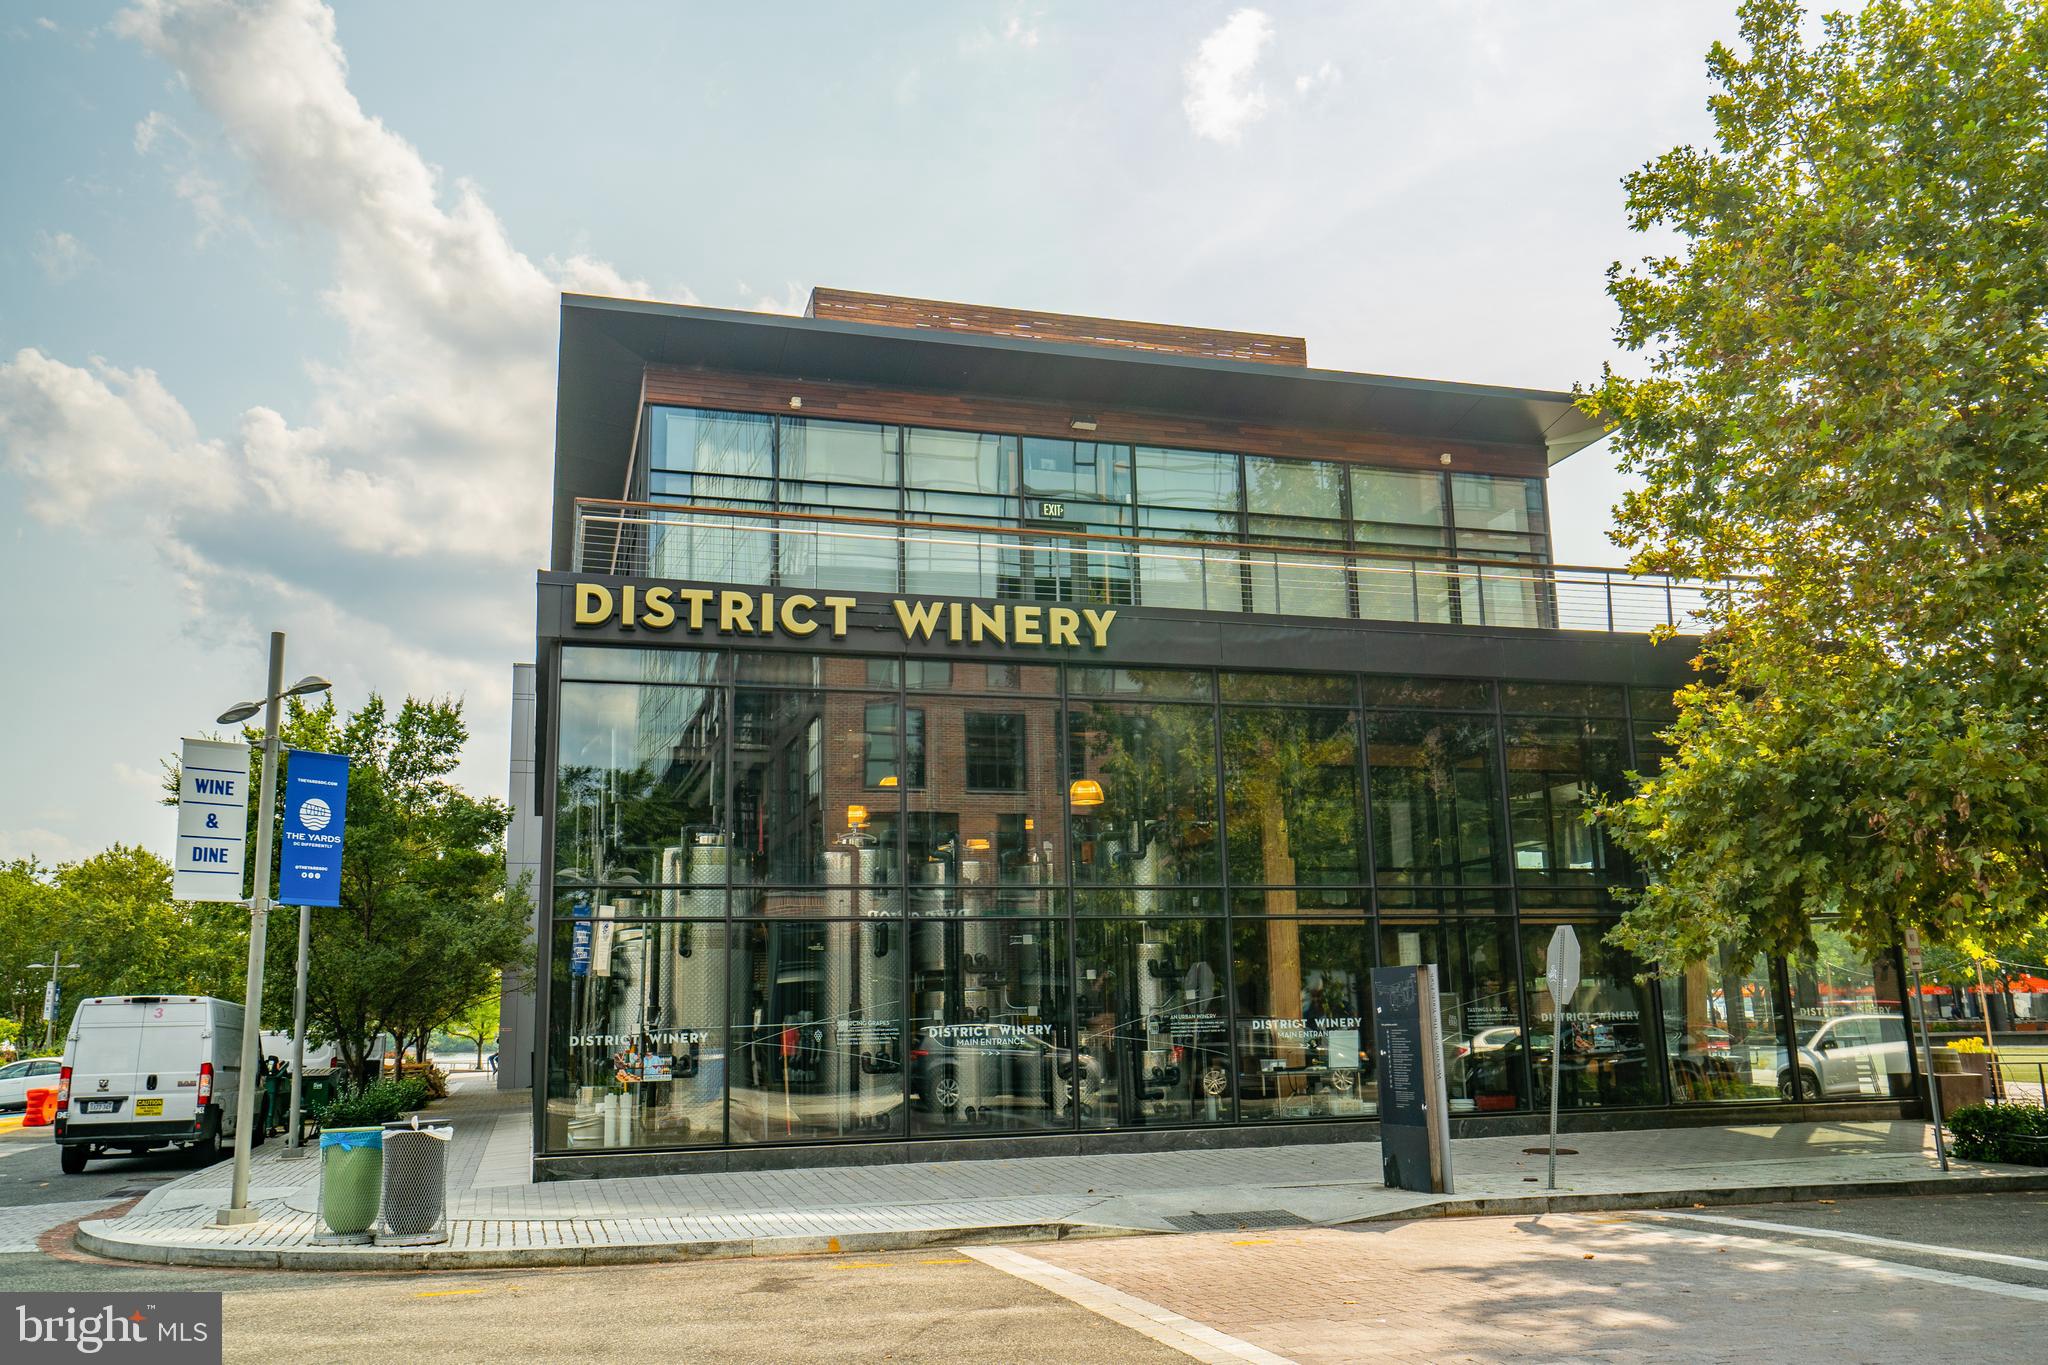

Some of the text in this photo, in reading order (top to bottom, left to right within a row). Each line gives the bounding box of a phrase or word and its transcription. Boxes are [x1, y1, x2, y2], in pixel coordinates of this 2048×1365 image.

[1043, 503, 1061, 516] EXIT
[574, 582, 1118, 648] DISTRICT WINERY
[195, 778, 235, 796] WINE
[205, 813, 219, 829] &
[286, 832, 341, 843] THE YARDS
[192, 846, 229, 864] DINE
[153, 1007, 164, 1019] 3
[1598, 1010, 1640, 1021] WINERY
[1252, 1017, 1362, 1030] DISTRICT WINERY
[928, 1024, 1052, 1038] DISTRICT WINERY
[1277, 1030, 1329, 1039] MAIN ENTRAN
[569, 1031, 709, 1047] DISTRICT WINERY
[956, 1037, 1025, 1047] MAIN ENTRANCE
